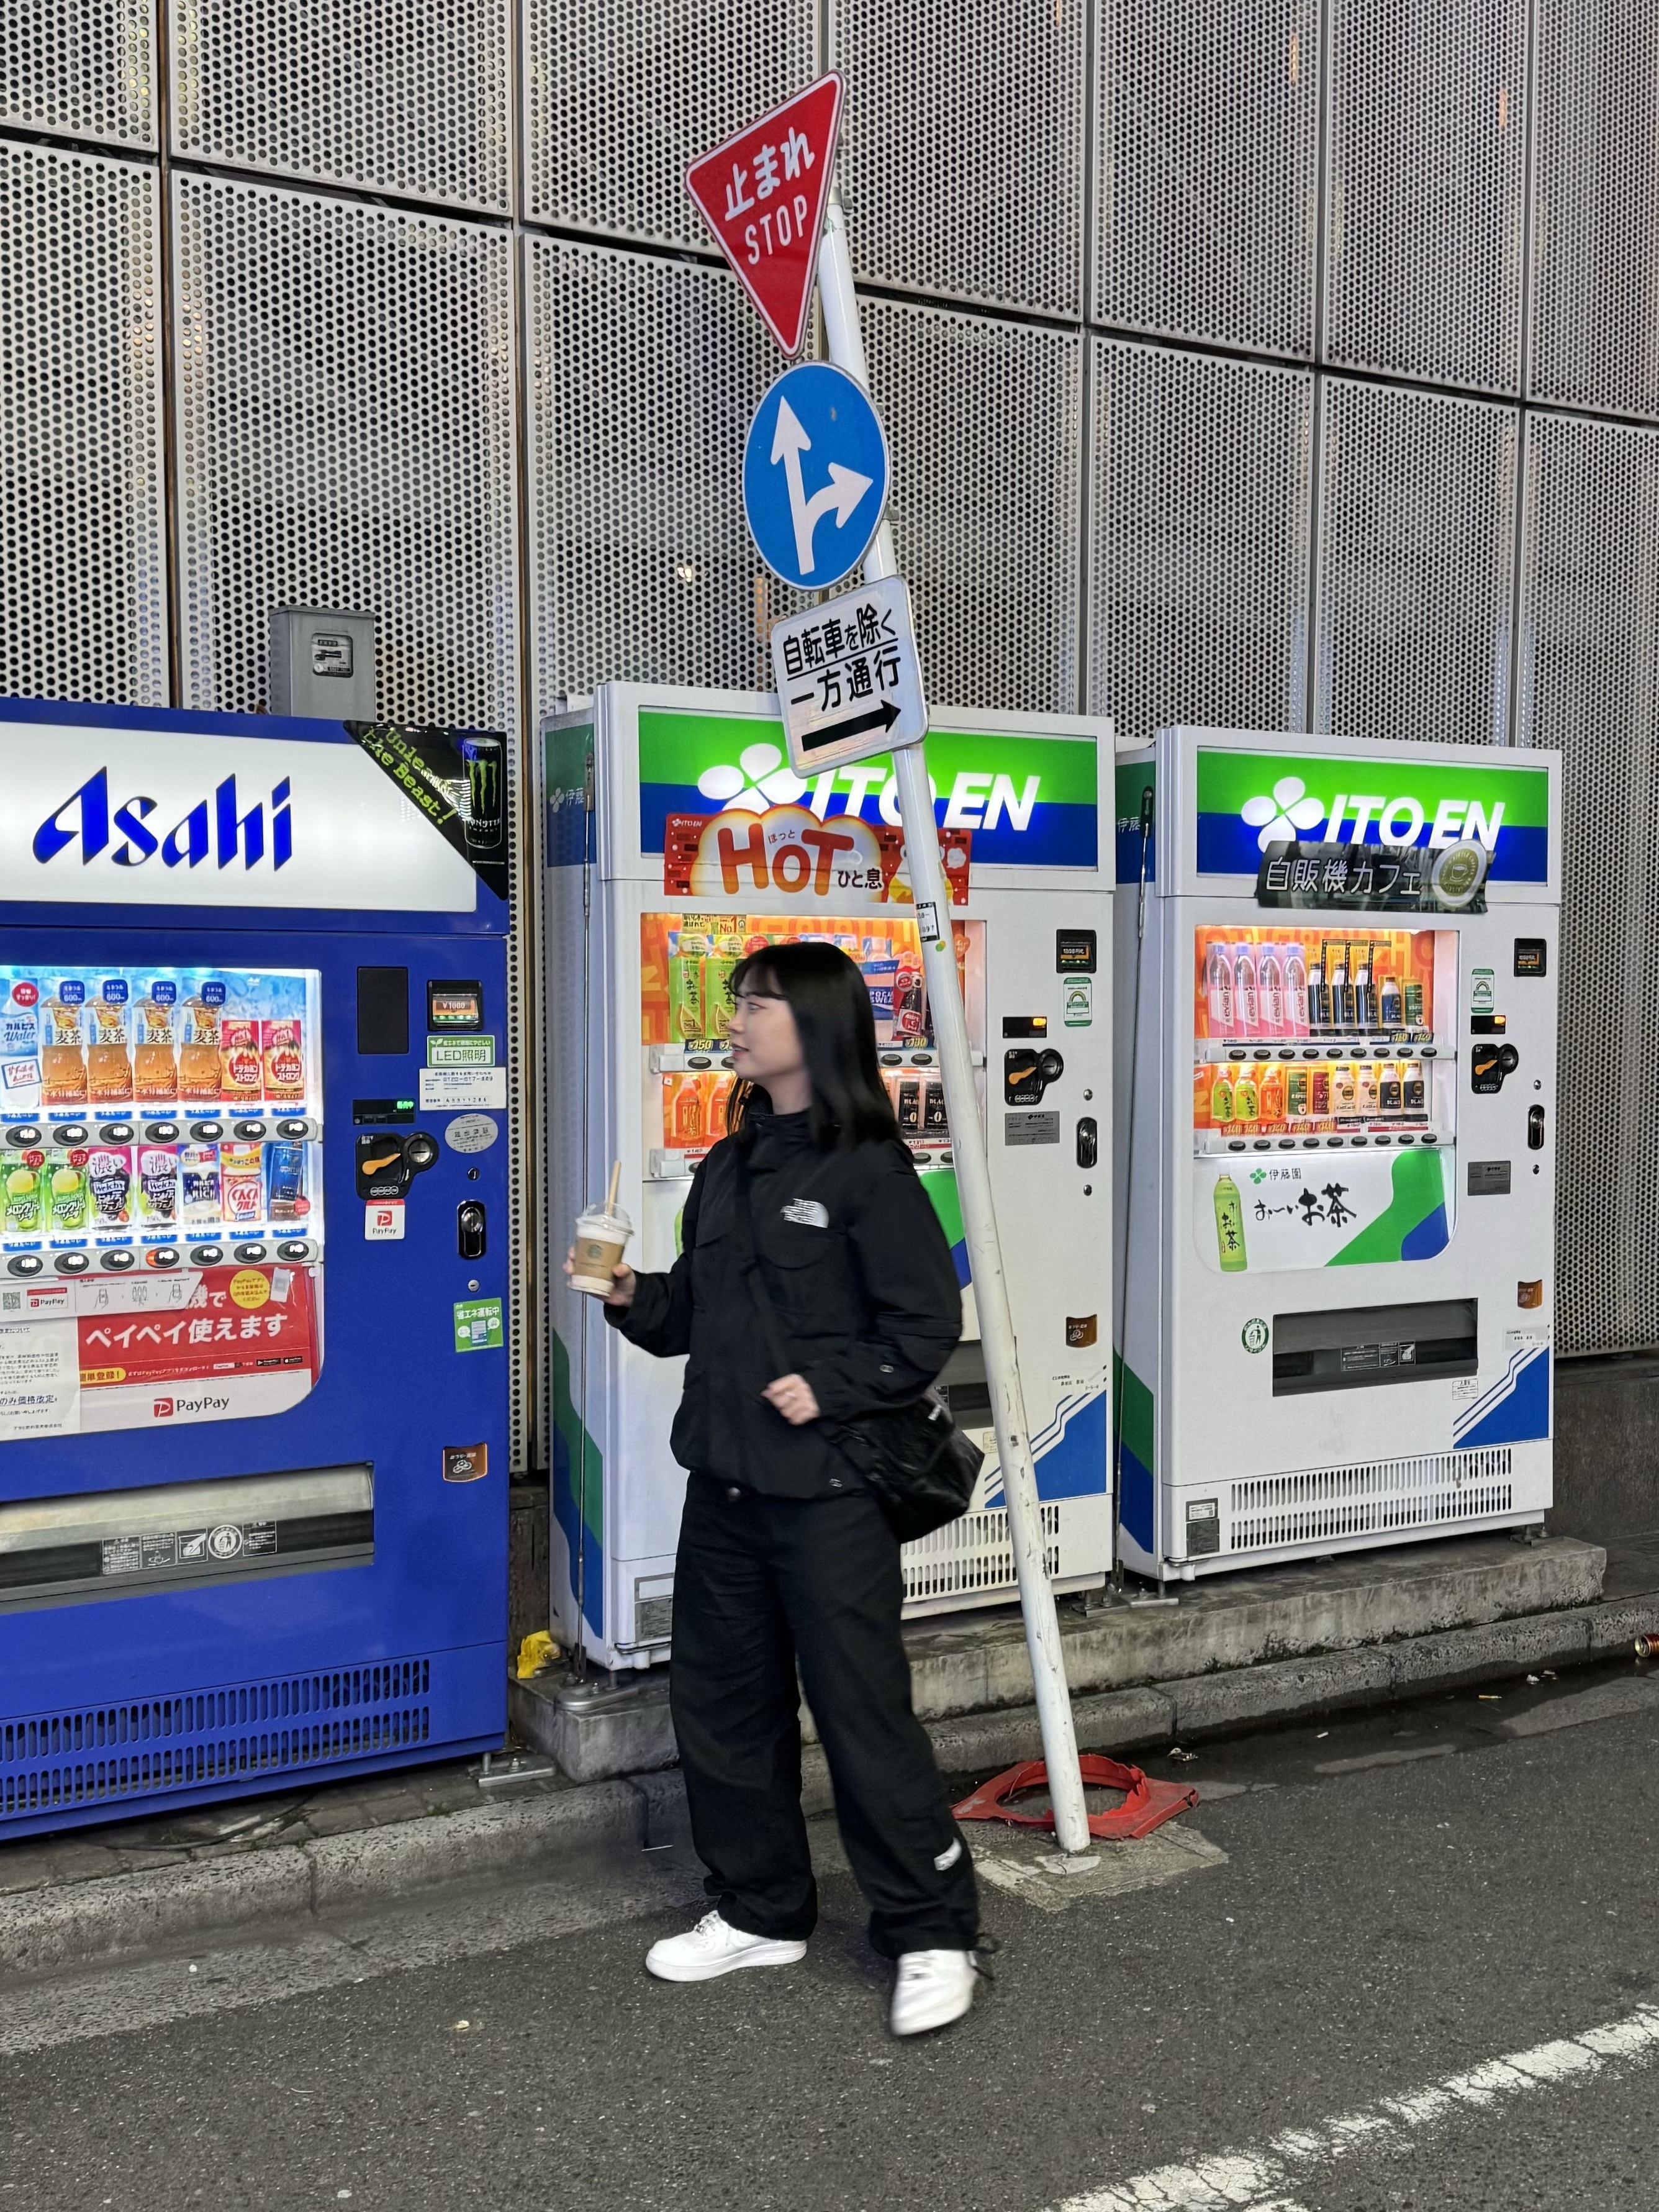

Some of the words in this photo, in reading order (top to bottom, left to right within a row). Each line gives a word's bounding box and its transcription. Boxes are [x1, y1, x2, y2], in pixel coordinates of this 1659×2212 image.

[723, 127, 816, 222] 止まれ
[745, 194, 808, 265] STOP
[783, 604, 896, 675] 自転車を除く
[790, 645, 901, 712] 一方通行
[393, 762, 457, 825] Beast!
[810, 766, 936, 827] ITO
[943, 772, 1041, 831] EN
[32, 765, 292, 872] Asahi
[1324, 795, 1424, 846] ITO
[1428, 799, 1505, 851] EN
[769, 830, 795, 844] ほっと
[838, 868, 884, 890] ひと息
[1266, 856, 1421, 895] 自販機カフェ
[1222, 992, 1230, 1017] evian
[4, 1031, 36, 1042] Water
[6, 1023, 35, 1031] カルピス
[55, 1030, 81, 1045] 麦茶
[99, 1029, 125, 1044] 麦茶
[147, 1029, 173, 1044] 麦茶
[194, 1030, 219, 1044] 麦茶
[436, 1049, 486, 1061] LED照明
[1269, 1167, 1301, 1180] 伊藤園
[86, 1313, 287, 1348] ペイペイ使えます
[176, 1397, 229, 1413] PayPay
